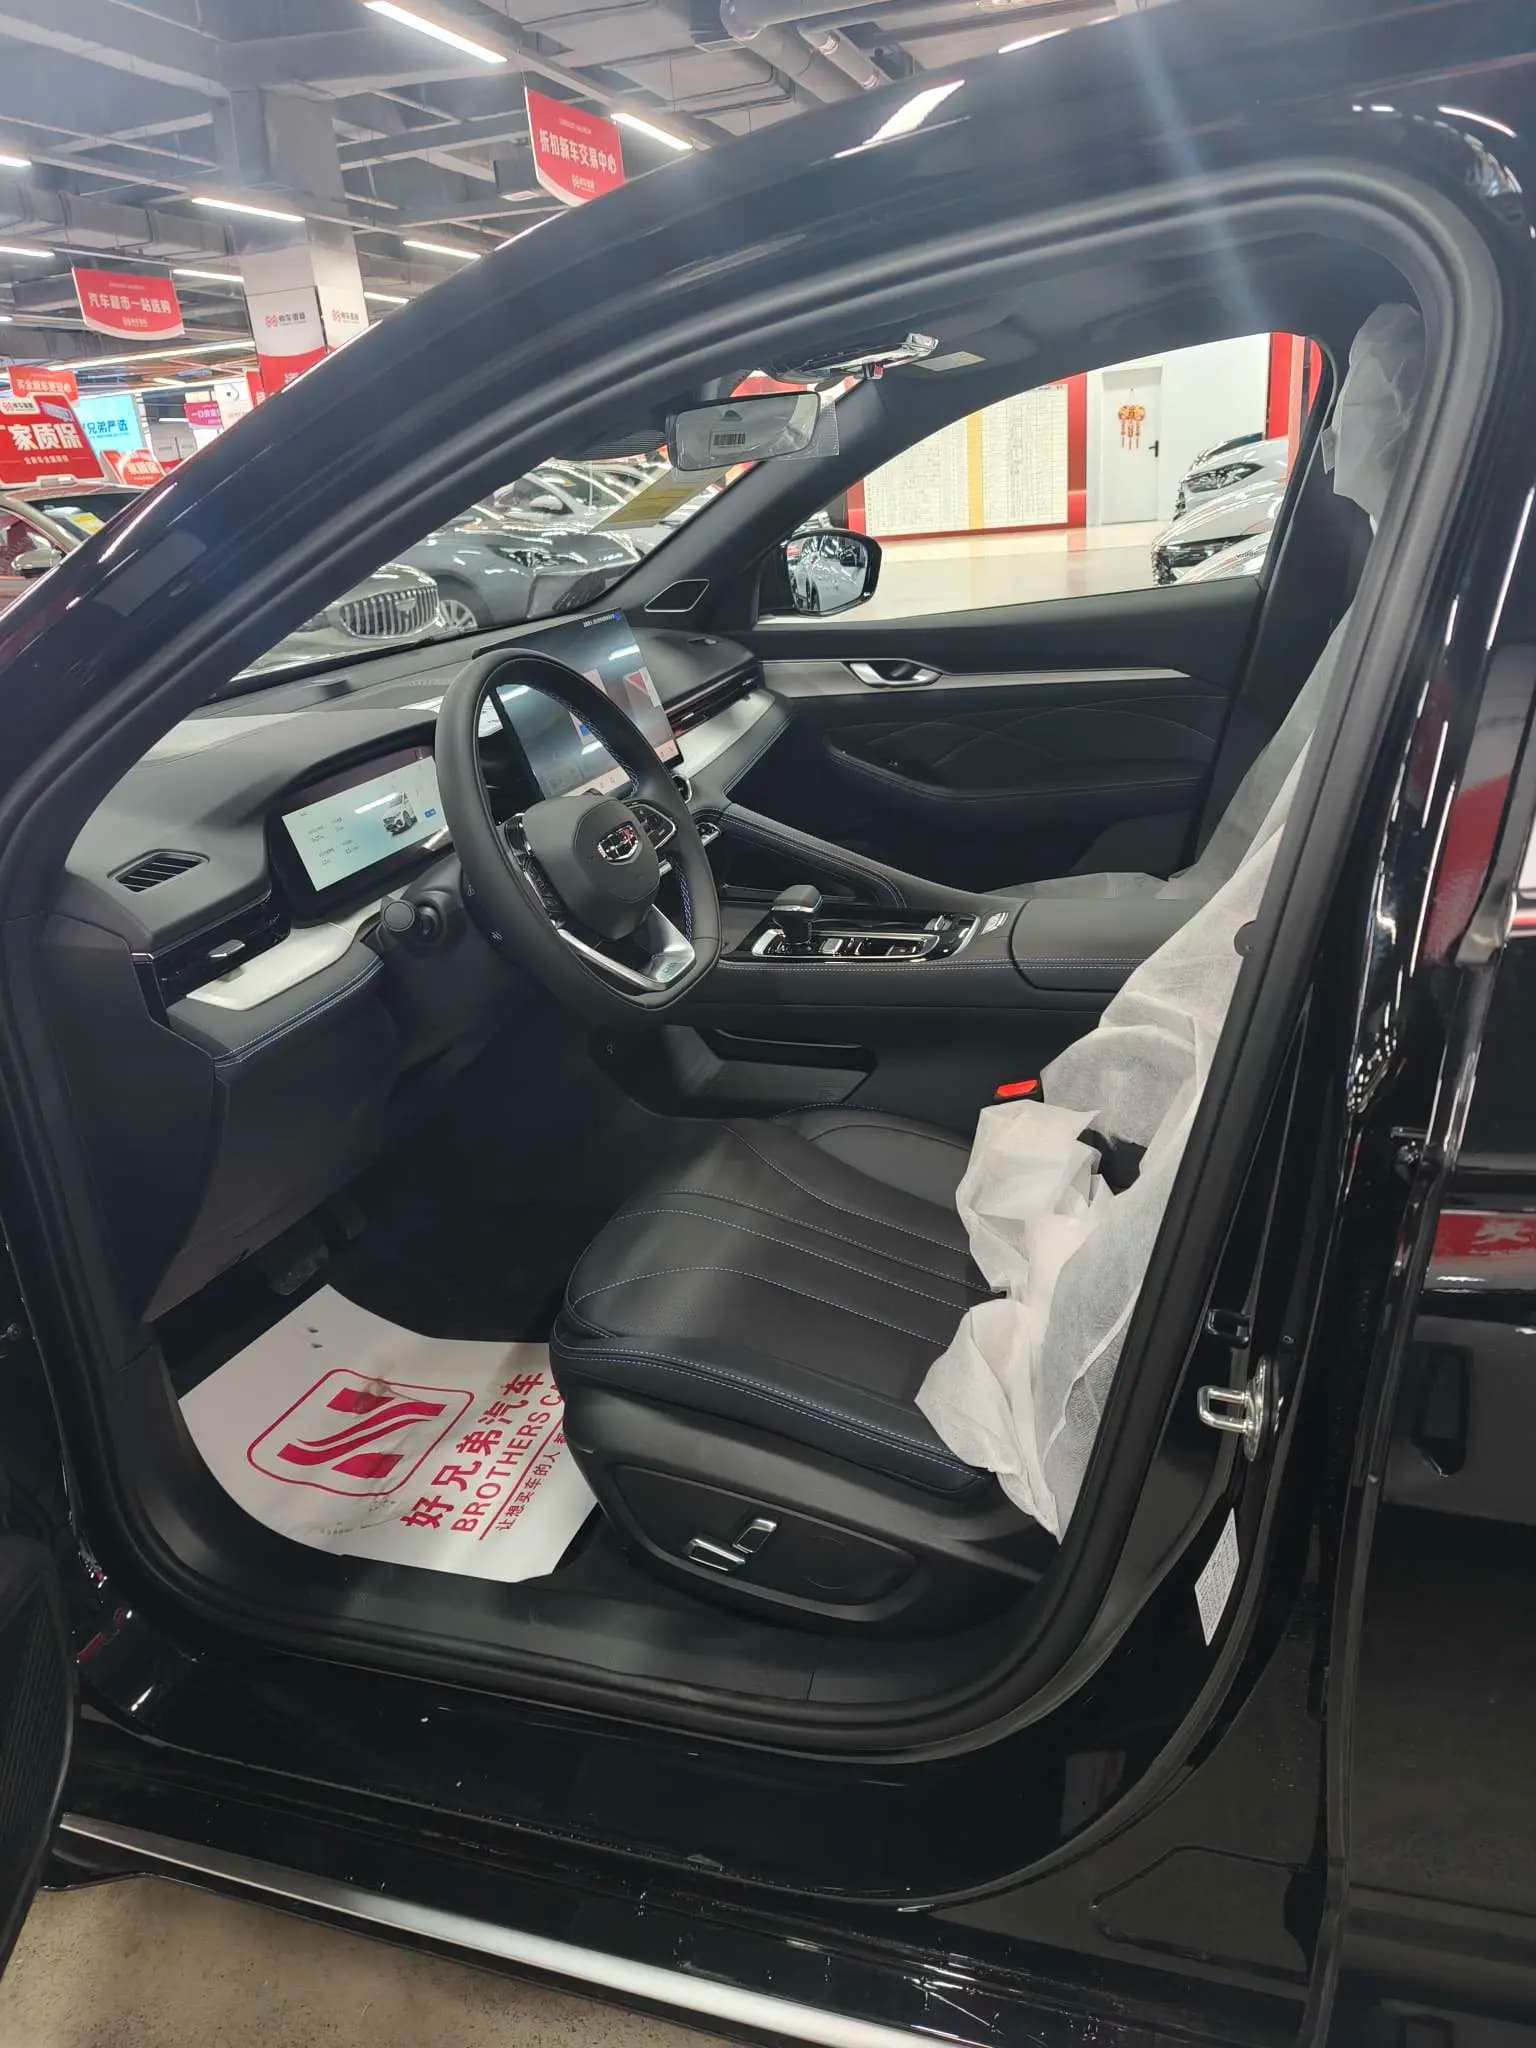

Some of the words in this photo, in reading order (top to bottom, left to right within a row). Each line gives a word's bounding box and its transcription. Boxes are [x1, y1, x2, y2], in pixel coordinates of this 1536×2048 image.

[539, 128, 617, 175] 折扣新车交易中心
[0, 423, 83, 451] 家质保
[82, 419, 129, 434] 兄弟严选
[400, 1373, 544, 1529] 好兄弟汽车
[450, 1412, 551, 1532] BROTHERS
[496, 1451, 561, 1532] 让想买车的人
